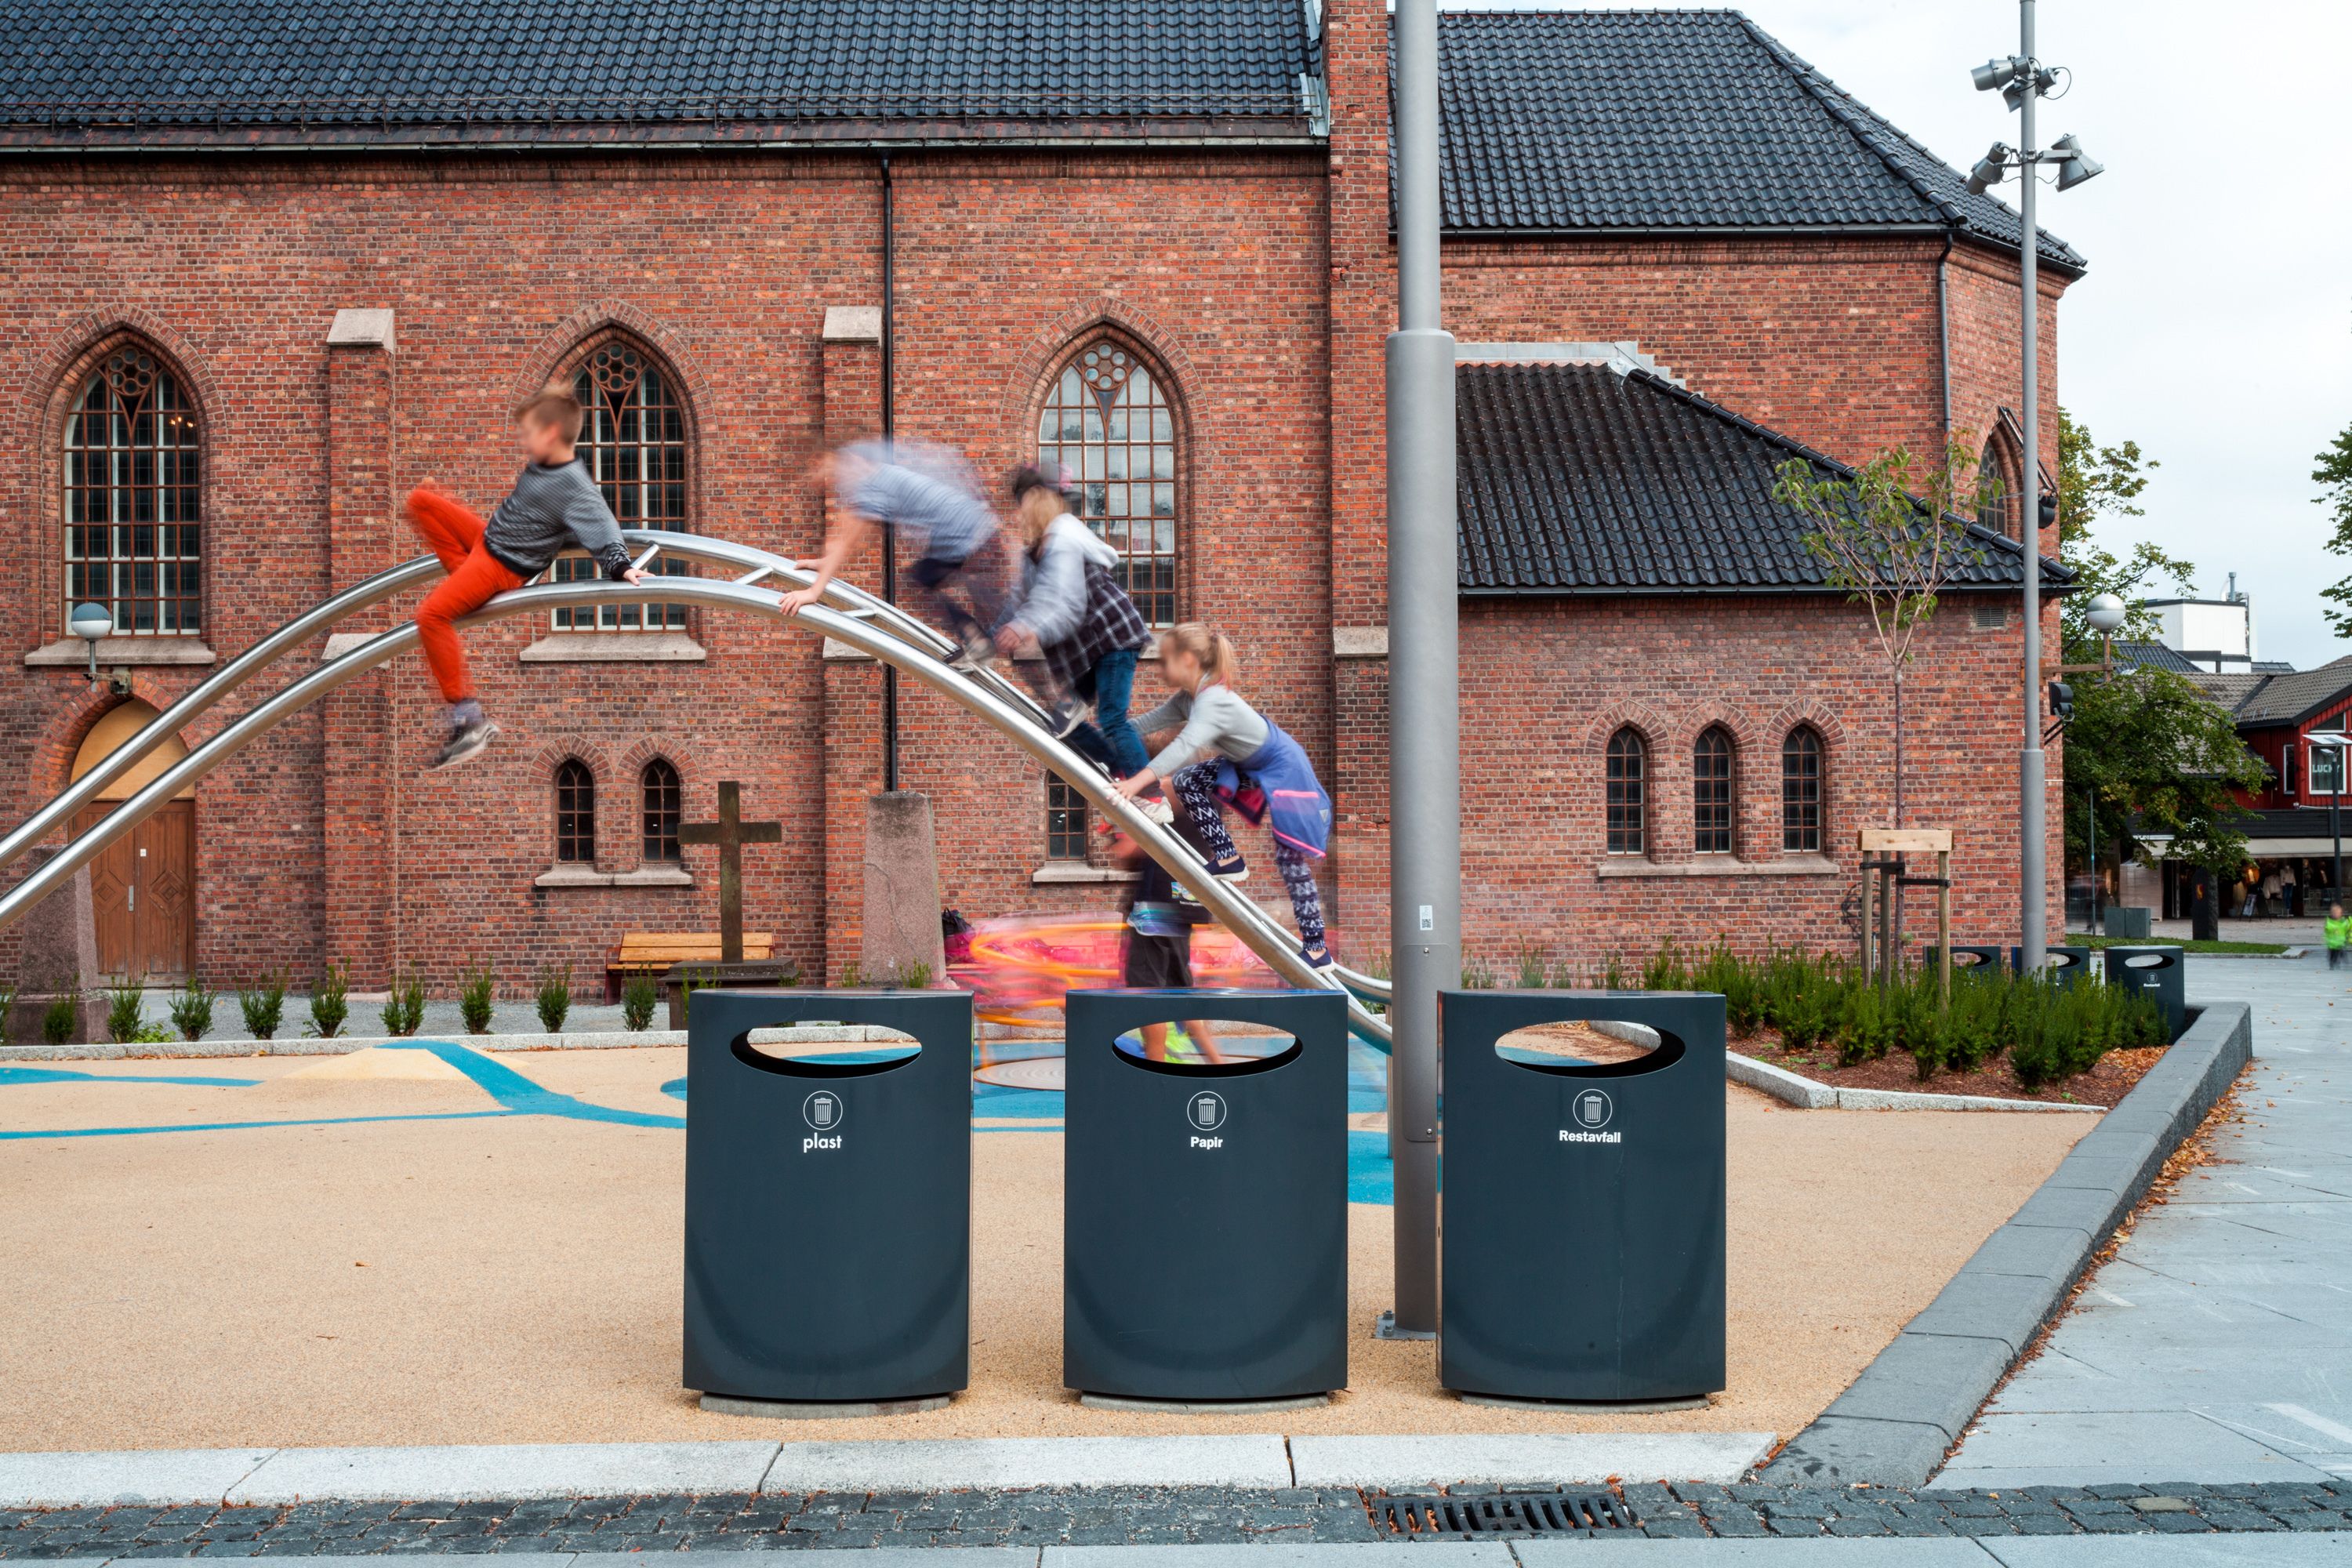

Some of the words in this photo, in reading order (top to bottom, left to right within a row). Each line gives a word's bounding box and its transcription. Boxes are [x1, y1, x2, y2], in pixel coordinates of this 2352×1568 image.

[804, 1132, 842, 1153] plast
[1190, 1136, 1223, 1150] Papir
[1559, 1130, 1621, 1143] Restavfall
